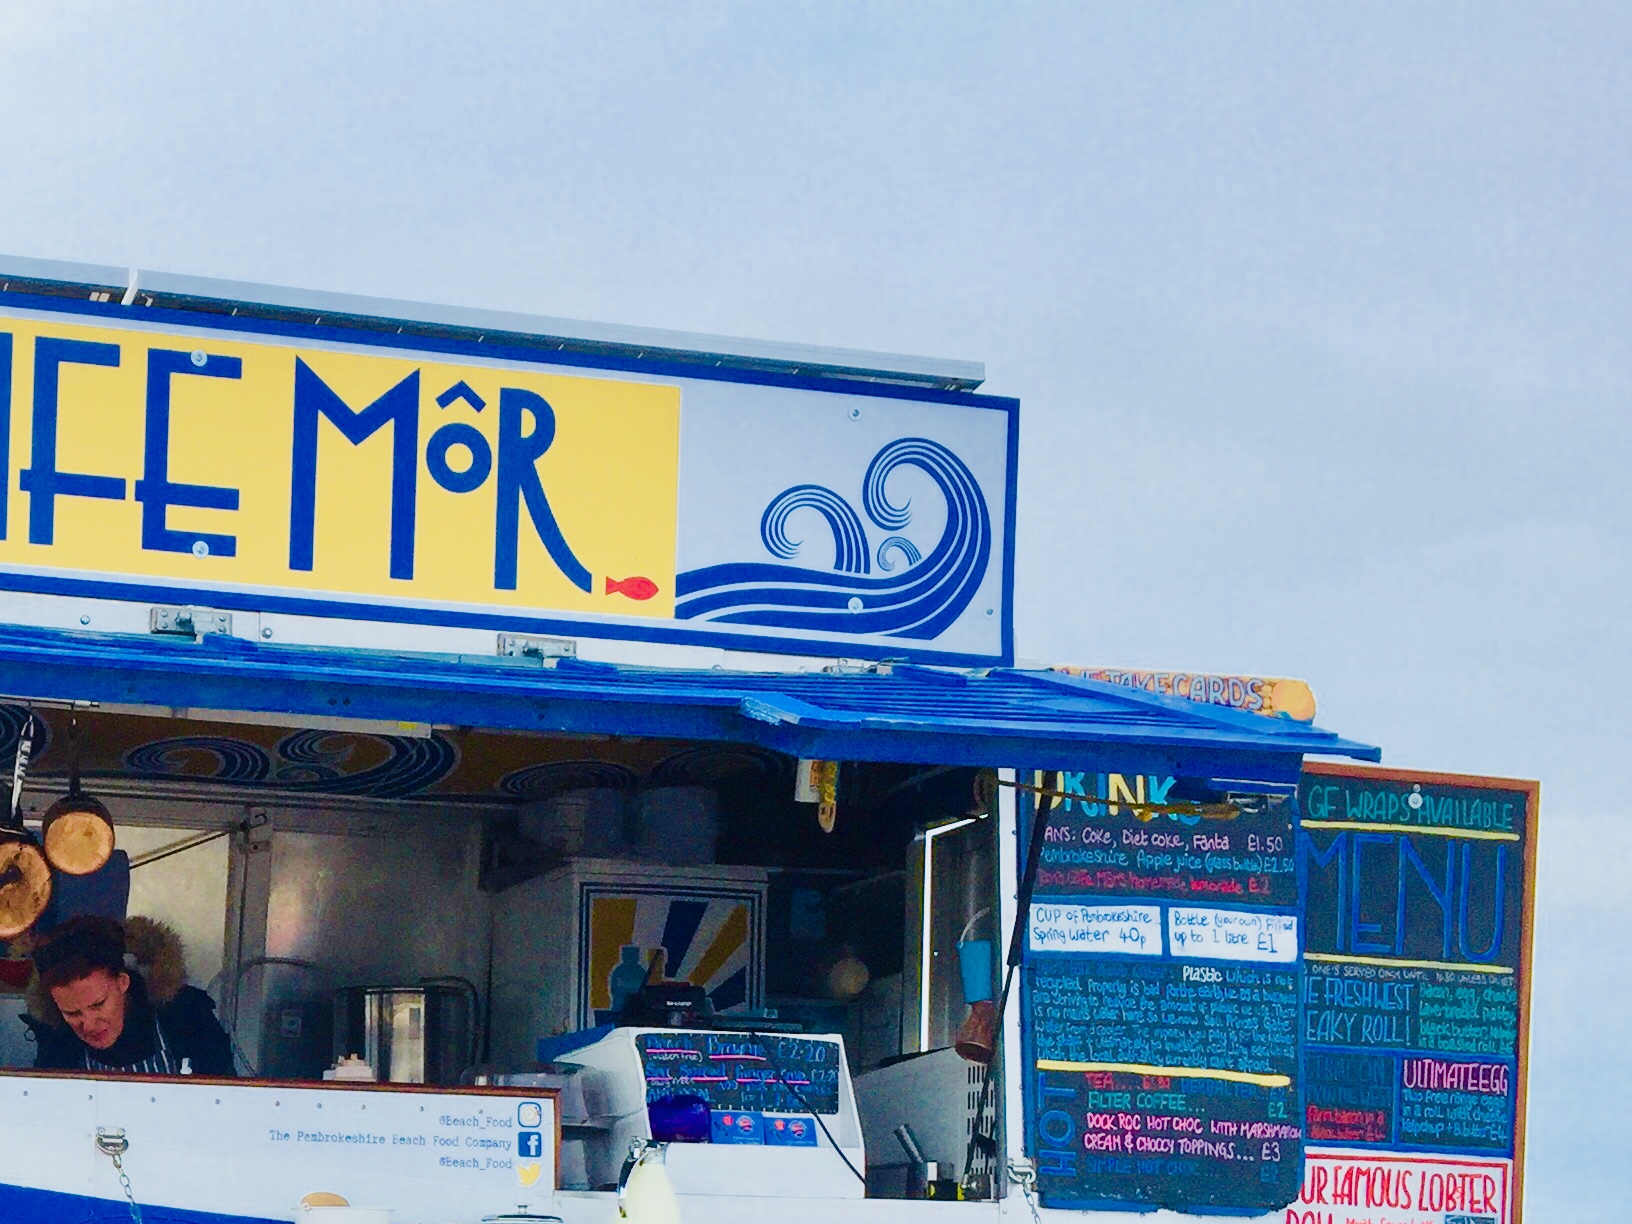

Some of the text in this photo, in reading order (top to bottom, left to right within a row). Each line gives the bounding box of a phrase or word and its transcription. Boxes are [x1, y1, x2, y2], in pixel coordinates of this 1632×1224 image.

[289, 351, 593, 597] MÔR
[1172, 676, 1263, 709] CARDS
[1308, 785, 1513, 830] GF WRAPS AVAILABLE
[1123, 830, 1148, 844] Diet
[1193, 835, 1230, 850] Fanta
[1248, 840, 1283, 852] £1.50
[1296, 831, 1506, 962] MENU
[1036, 905, 1061, 922] CUP
[1033, 928, 1147, 948] Spring 40p
[1088, 1091, 1288, 1119] FILTER £2
[439, 1116, 512, 1129] @Beach_Food
[1147, 1117, 1238, 1135] HOT CHOC WITH
[269, 1130, 511, 1150] The Pembrokeshire Beach Food Company
[1085, 1133, 1280, 1162] CREAM £3
[439, 1157, 512, 1170] @Beach_Food
[1332, 1166, 1412, 1209] FAMOUS
